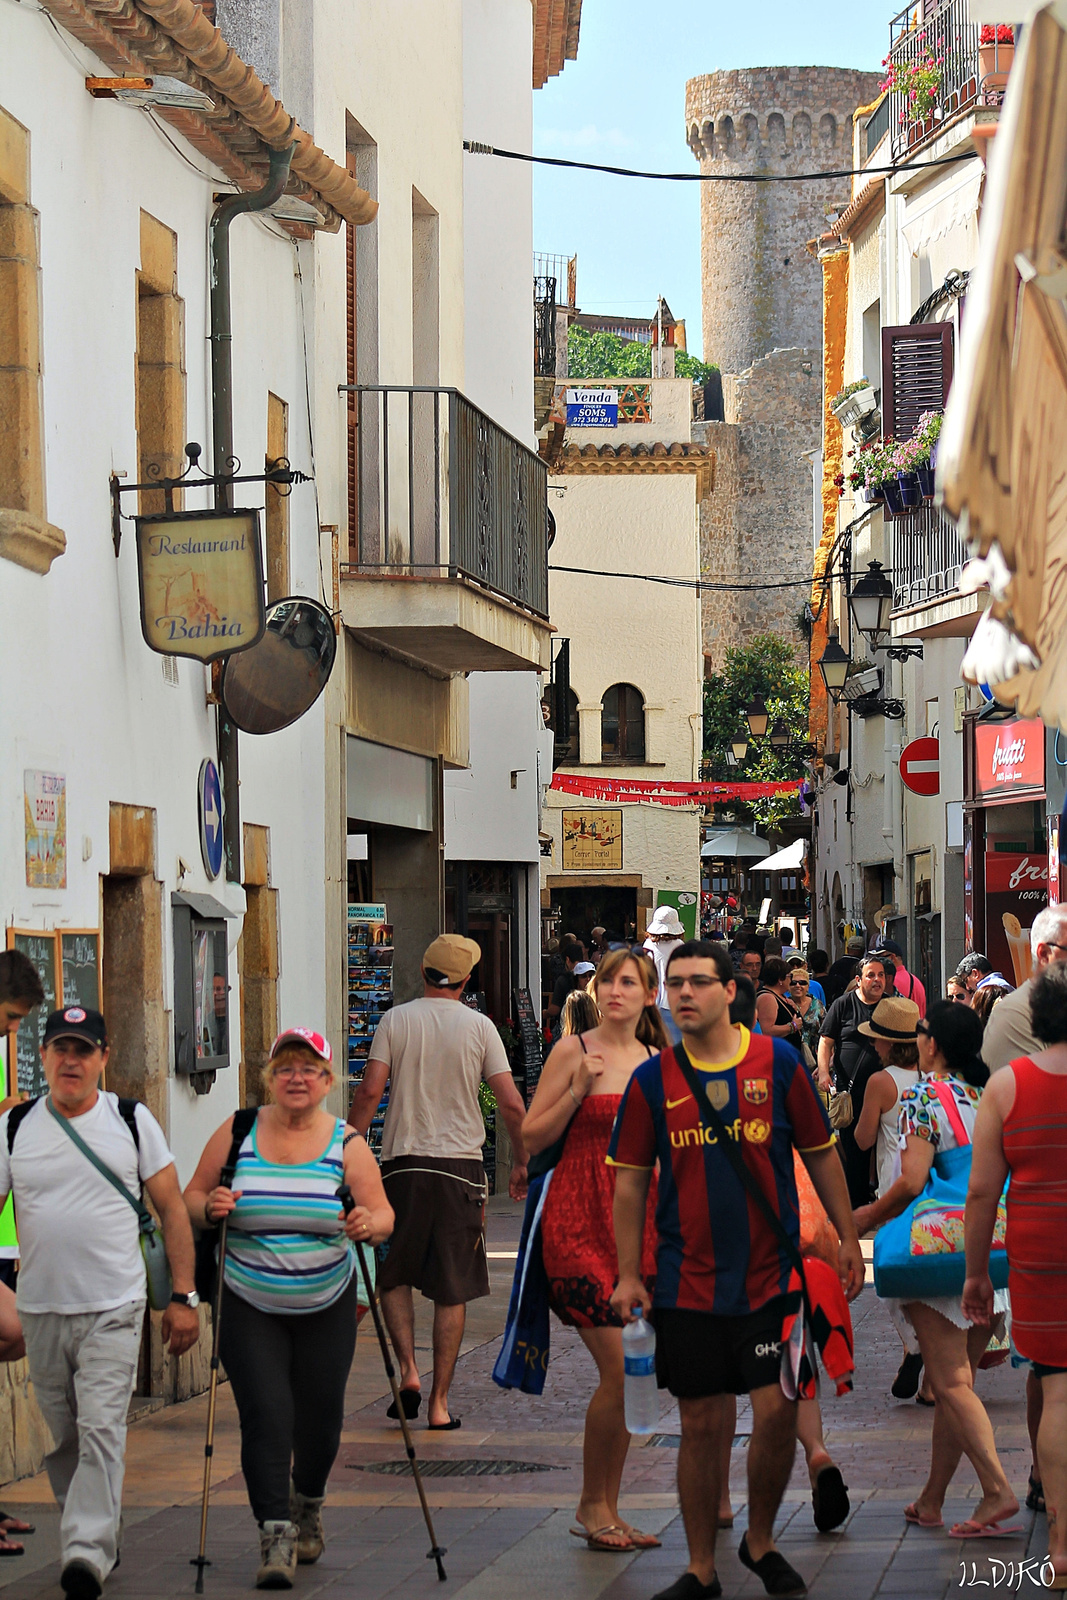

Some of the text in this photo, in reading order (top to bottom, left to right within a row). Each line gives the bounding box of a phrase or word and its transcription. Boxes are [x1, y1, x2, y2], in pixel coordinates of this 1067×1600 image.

[574, 392, 612, 403] Venda
[579, 409, 607, 417] SOMS
[148, 534, 246, 557] Restaurant
[155, 613, 245, 641] Bahia
[992, 735, 1026, 776] frutti
[1018, 890, 1040, 900] 100%
